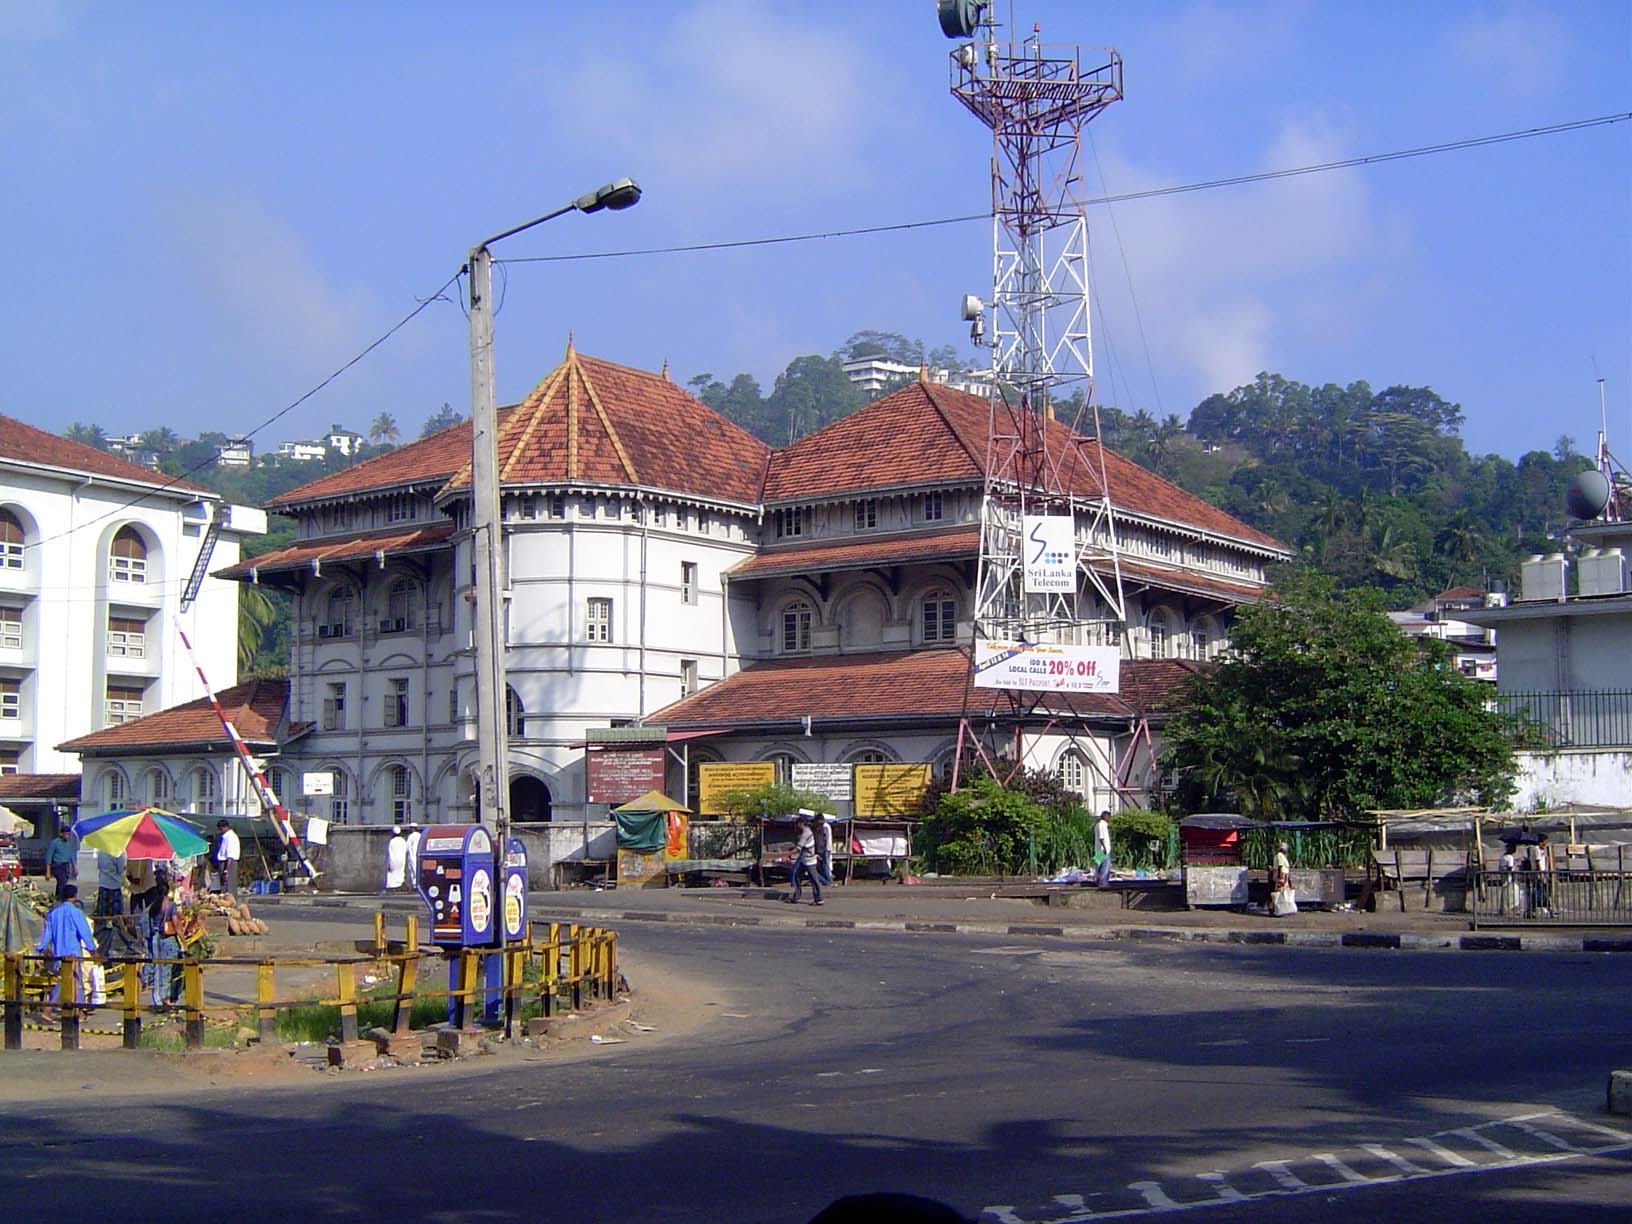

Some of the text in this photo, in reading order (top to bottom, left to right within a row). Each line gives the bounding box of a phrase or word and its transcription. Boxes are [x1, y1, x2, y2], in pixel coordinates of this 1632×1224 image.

[1032, 578, 1069, 587] Telecom
[1009, 665, 1047, 674] LOCAL CALLS
[1048, 660, 1075, 675] 20%
